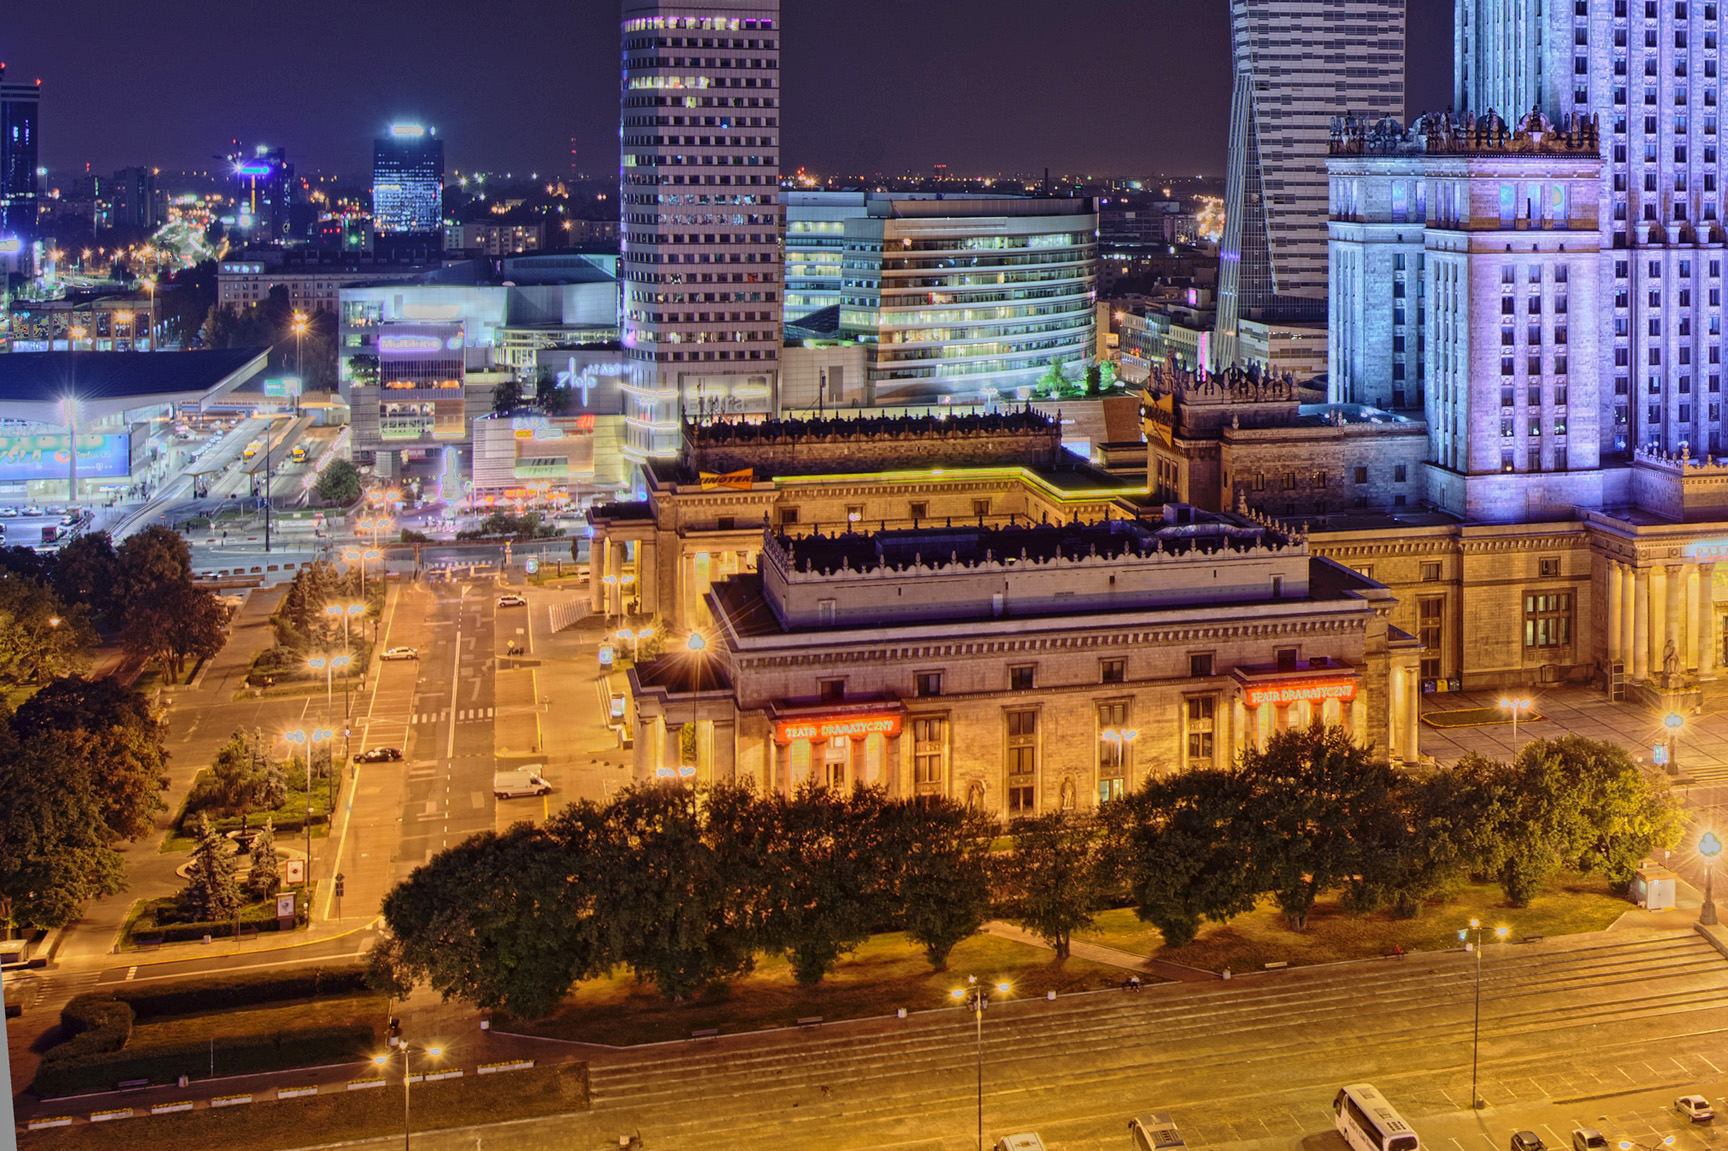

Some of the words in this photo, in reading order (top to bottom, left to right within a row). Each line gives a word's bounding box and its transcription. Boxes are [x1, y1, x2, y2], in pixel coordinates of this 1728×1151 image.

[1251, 690, 1281, 703] TEATR
[1281, 685, 1354, 702] DRAMATYCZNY
[784, 727, 817, 738] TEATR
[821, 719, 894, 736] DRAMATYCZNY
